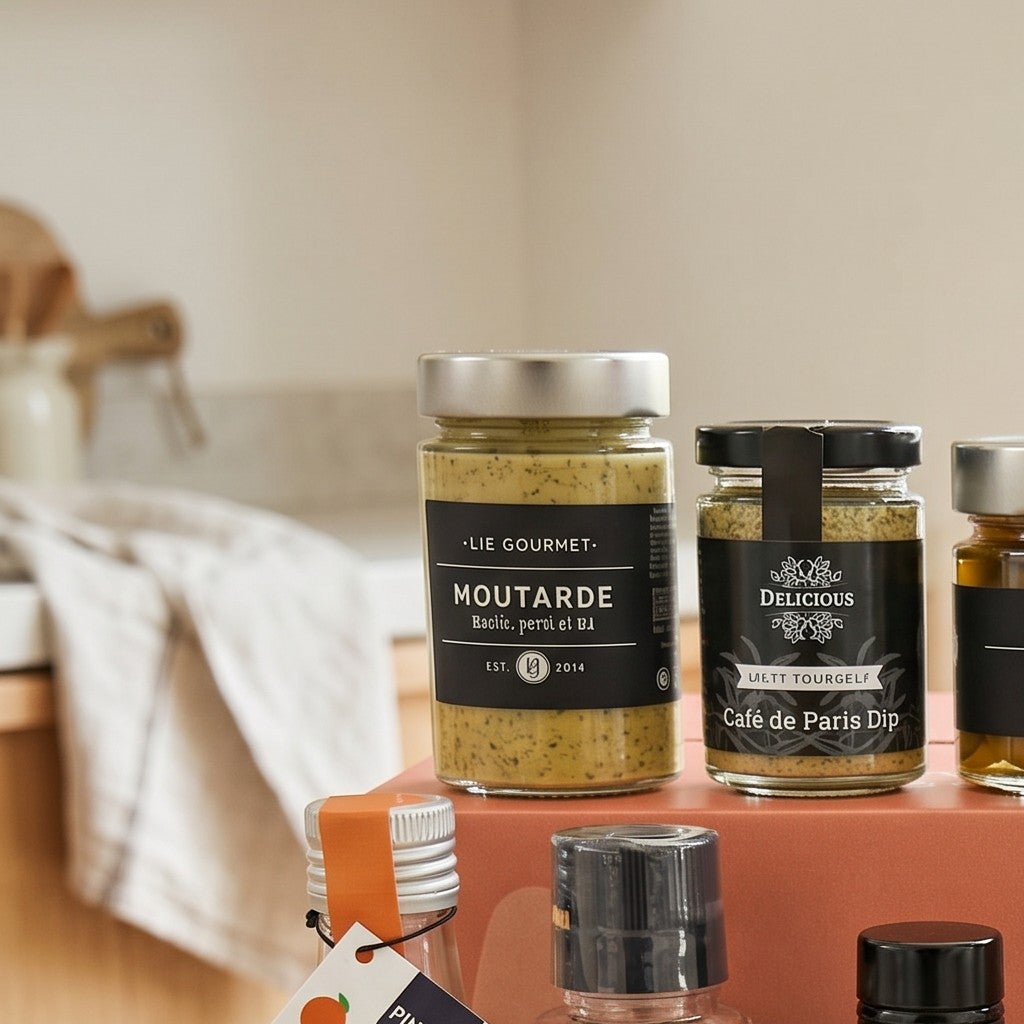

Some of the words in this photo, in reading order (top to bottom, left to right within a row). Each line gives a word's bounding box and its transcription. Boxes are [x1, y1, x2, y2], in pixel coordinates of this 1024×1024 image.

[470, 536, 495, 551] LIE
[502, 537, 591, 552] GOURMET
[453, 582, 613, 609] MOUTARDE
[559, 617, 573, 631] et
[486, 661, 510, 672] EST.
[555, 662, 585, 672] 2014
[723, 706, 764, 729] Café
[769, 710, 796, 730] de
[803, 710, 861, 731] Paris
[867, 709, 899, 732] Dip
